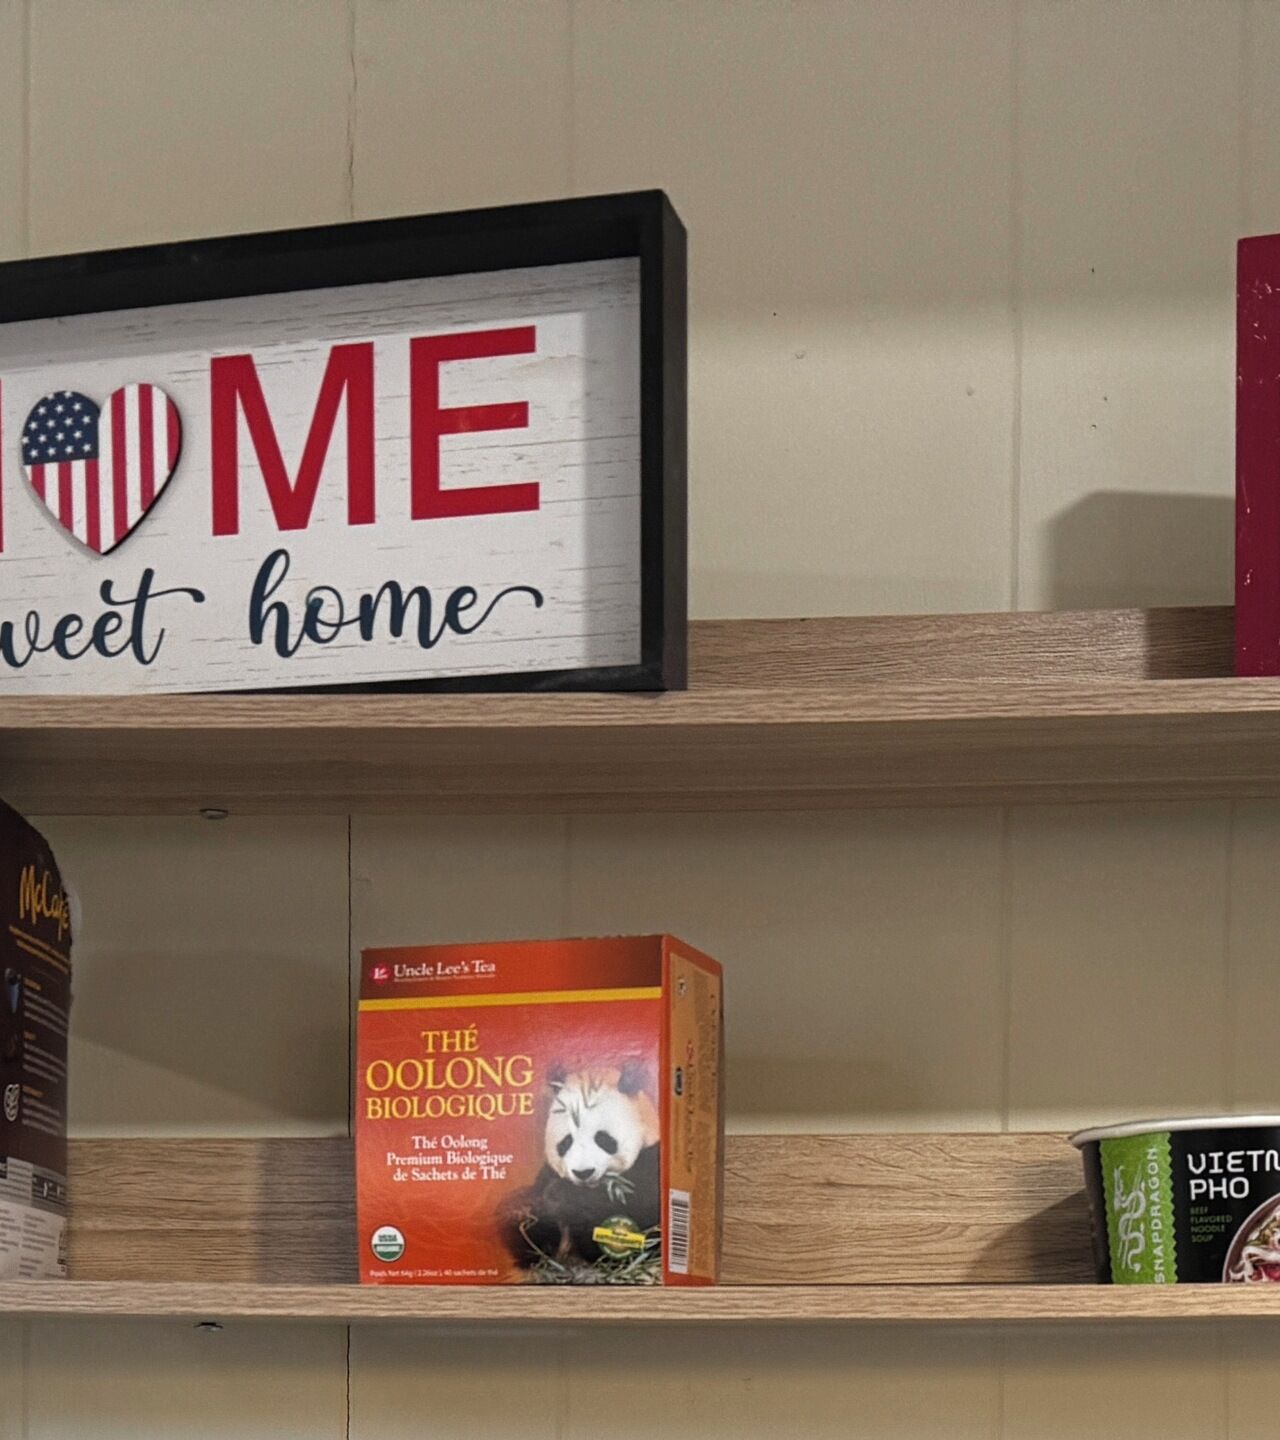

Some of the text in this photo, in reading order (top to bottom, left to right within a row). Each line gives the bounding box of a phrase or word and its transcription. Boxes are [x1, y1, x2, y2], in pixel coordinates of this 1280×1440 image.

[248, 548, 541, 658] home
[394, 959, 496, 977] Uncle Lee's Tea
[420, 1024, 478, 1053] THÉ
[365, 1055, 535, 1091] OOLONG
[365, 1093, 535, 1121] BIOLOGIQUE
[412, 1135, 488, 1152] Thé Oolong
[387, 1151, 513, 1169] Premium Biologique
[393, 1166, 506, 1182] de Sachets de Thé
[1189, 1177, 1250, 1200] PHO
[1147, 1147, 1165, 1283] SNAPDRAGON
[1190, 1206, 1208, 1214] BEEF
[1190, 1215, 1232, 1224] FLAVORED
[1190, 1224, 1225, 1232] NOODLE
[1191, 1234, 1214, 1243] SOUP
